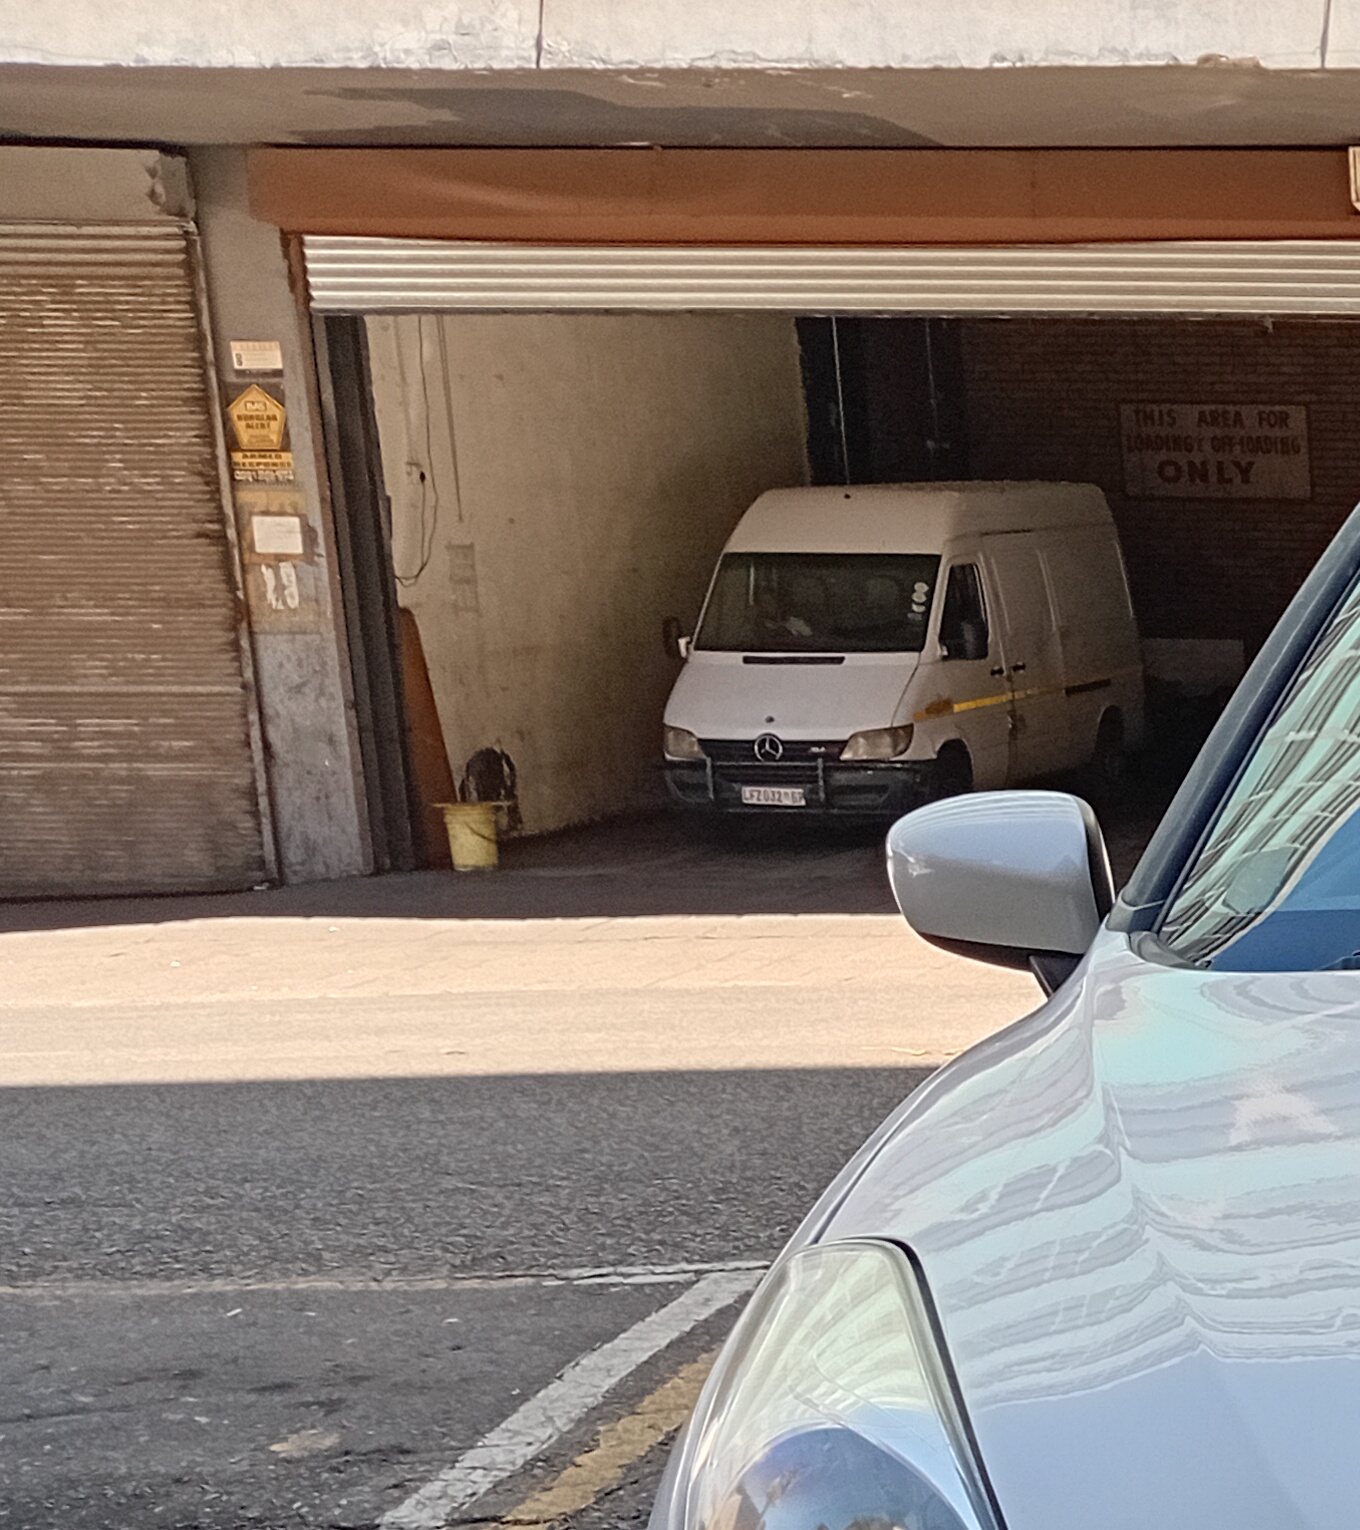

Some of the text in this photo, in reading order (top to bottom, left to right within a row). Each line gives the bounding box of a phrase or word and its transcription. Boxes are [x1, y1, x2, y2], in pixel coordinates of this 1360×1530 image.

[1133, 409, 1290, 428] THIS AREA FOR
[1156, 460, 1256, 485] ONLY
